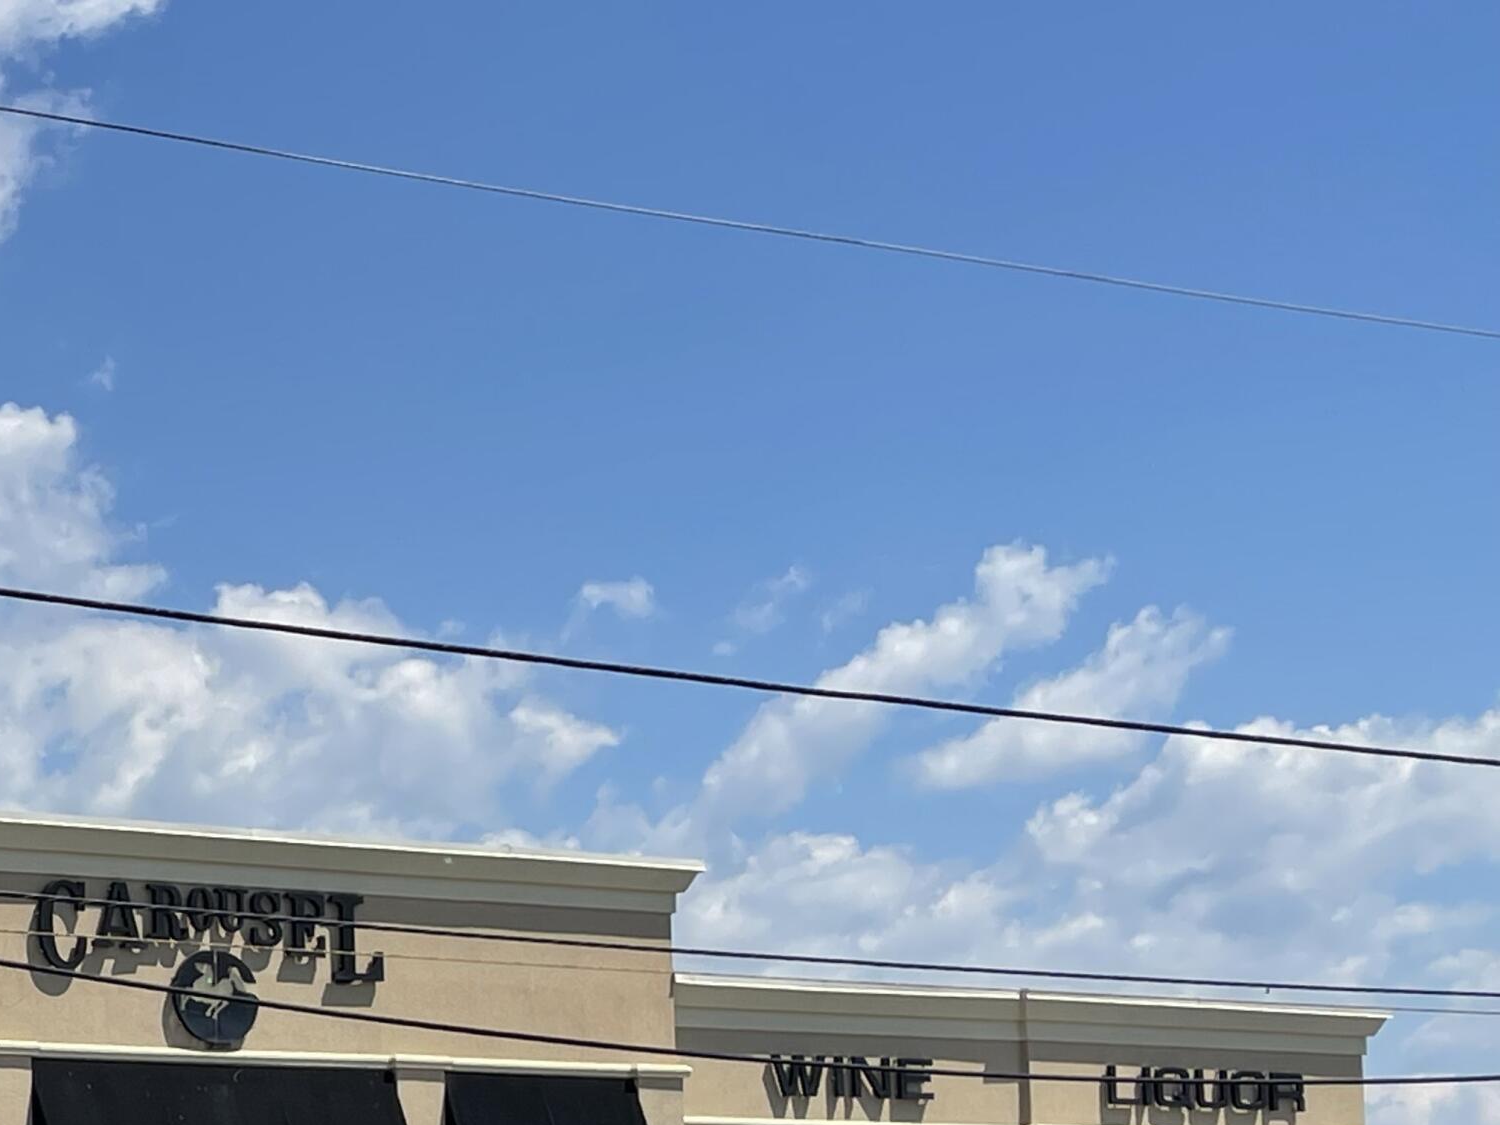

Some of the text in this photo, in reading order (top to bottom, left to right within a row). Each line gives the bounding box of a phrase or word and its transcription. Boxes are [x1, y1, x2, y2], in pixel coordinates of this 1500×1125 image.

[37, 879, 385, 983] CAROUSEL
[768, 1052, 935, 1101] WINE
[1102, 1063, 1307, 1113] LIQUOR
